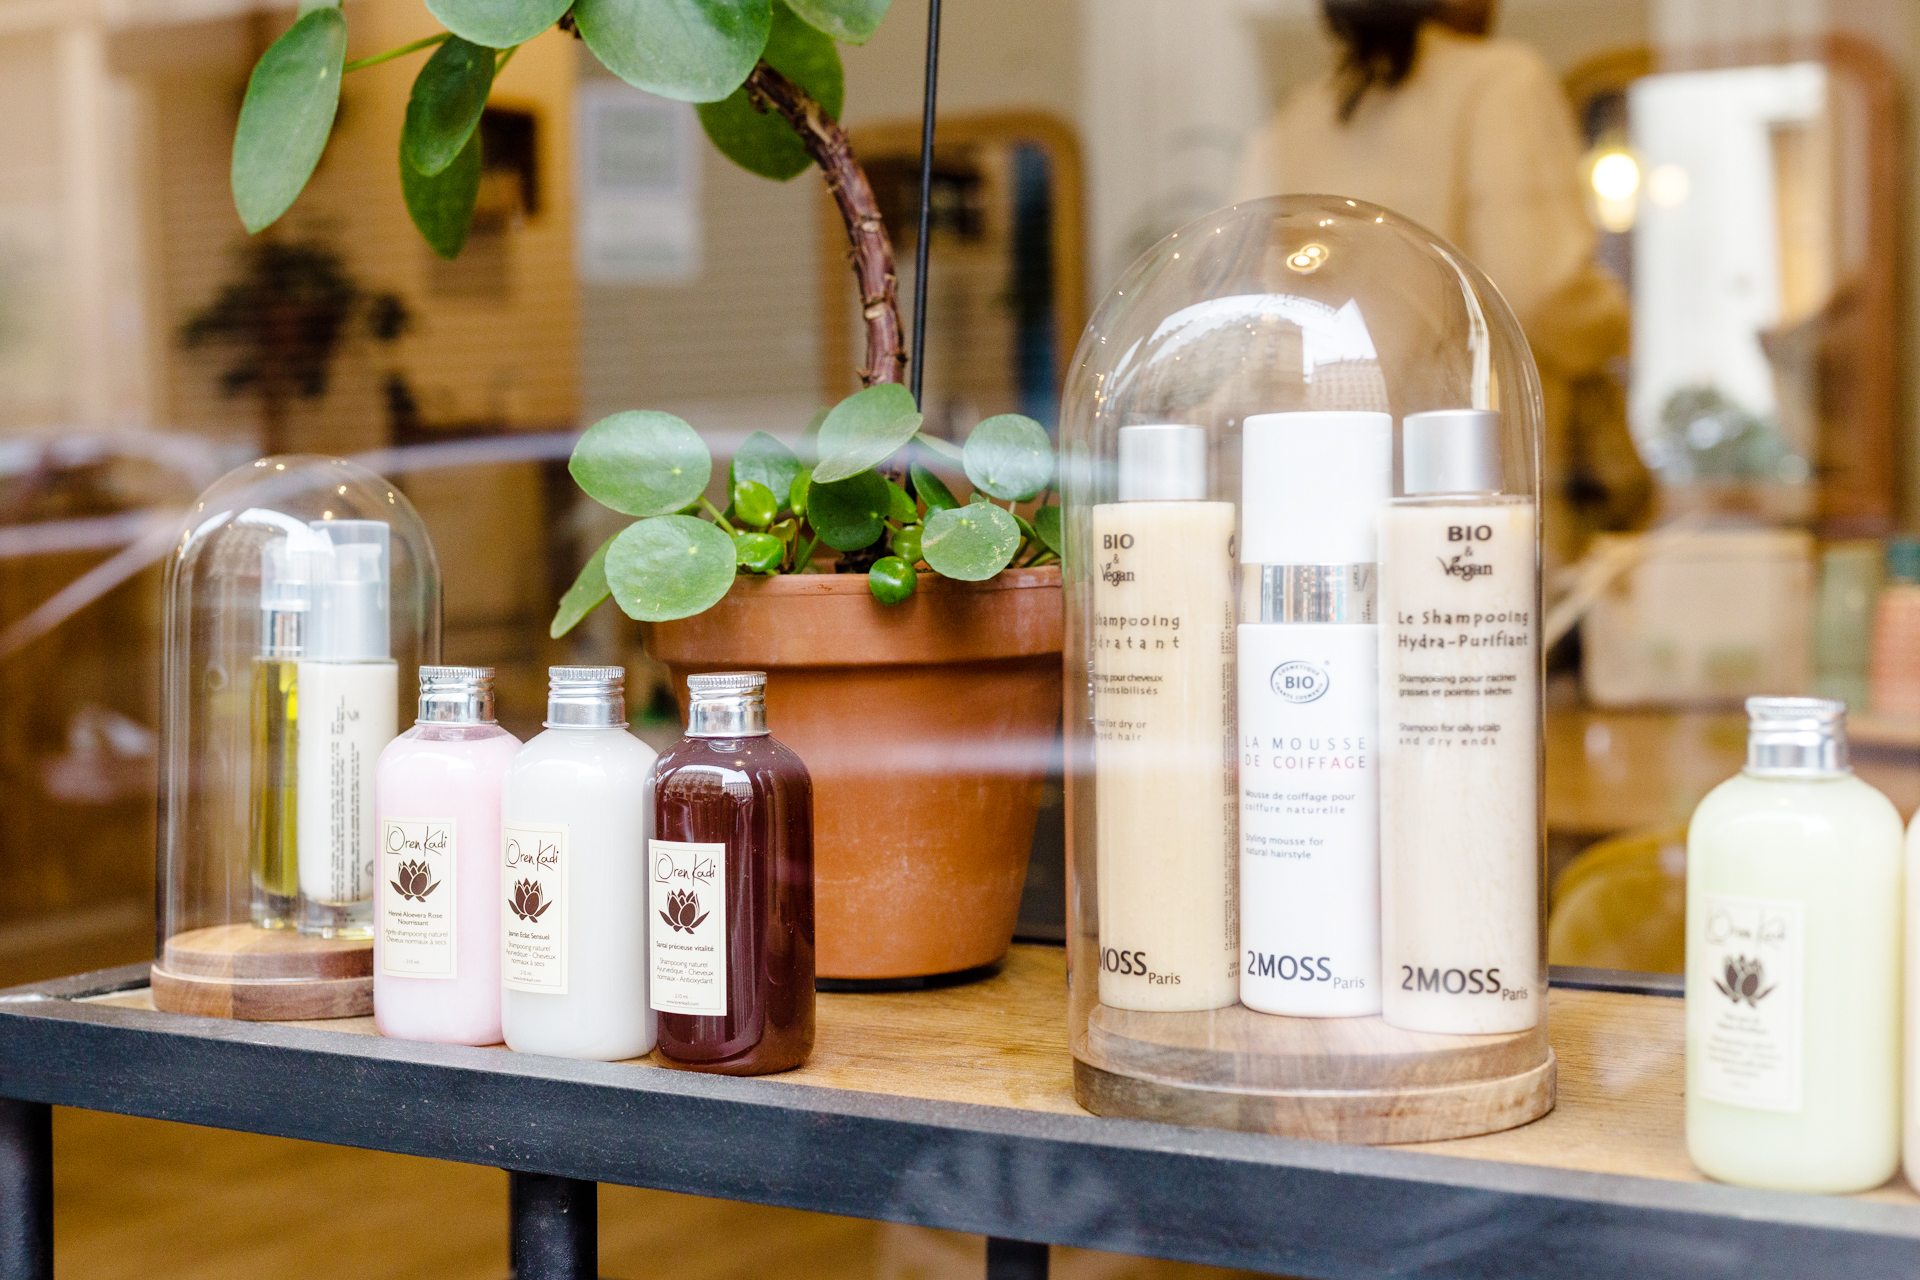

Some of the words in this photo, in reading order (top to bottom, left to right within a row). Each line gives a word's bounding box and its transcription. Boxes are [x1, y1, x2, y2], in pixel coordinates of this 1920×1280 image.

[1448, 524, 1492, 542] BIO
[1103, 533, 1135, 550] BIO
[1113, 553, 1120, 564] &
[1398, 611, 1414, 625] Le
[1422, 608, 1529, 627] Shampooing
[1095, 635, 1180, 650] dratant
[1398, 630, 1529, 652] Hydra-Purifiant
[1110, 674, 1125, 683] pour
[1127, 673, 1163, 682] cheveux
[1285, 676, 1315, 689] BIO
[1399, 673, 1456, 684] Shampooing
[1459, 675, 1482, 684] pour
[1486, 674, 1517, 682] racines
[1399, 688, 1429, 697] grasses
[1431, 688, 1441, 696] et
[1444, 688, 1480, 698] pointes
[1118, 719, 1133, 730] dry
[1440, 723, 1455, 732] for
[1457, 723, 1475, 734] oily
[1477, 724, 1501, 733] scalp
[1118, 732, 1141, 741] hair
[1245, 735, 1260, 749] LA
[1272, 737, 1366, 751] MOUSSE
[1428, 737, 1452, 747] dry
[1461, 737, 1497, 746] ends
[1245, 753, 1260, 767] DE
[1273, 756, 1366, 769] COIFFAGE
[1245, 789, 1270, 800] Mousse
[1272, 792, 1283, 800] de
[1286, 792, 1328, 802] coiffage
[1331, 794, 1355, 802] pour
[1245, 802, 1280, 813] coiffure
[1286, 805, 1345, 814] naturelle
[424, 825, 447, 857] Kadi
[1245, 832, 1267, 845] Styling
[1269, 837, 1306, 845] mousse
[1309, 837, 1324, 846] for
[537, 839, 559, 872] Kadi
[1245, 847, 1268, 856] natural
[1270, 848, 1312, 860] hairstyle
[692, 853, 716, 886] Kadi
[398, 918, 429, 926] Nourrissant
[386, 935, 404, 943] Cheveux
[532, 952, 556, 960] Cheveux
[688, 968, 714, 977] Cheveux
[1247, 950, 1332, 982] 2MOSS
[1333, 976, 1365, 989] Paris
[1148, 972, 1181, 985] Paris
[1402, 965, 1501, 994] 2MOSS
[1502, 987, 1528, 1001] Paris
